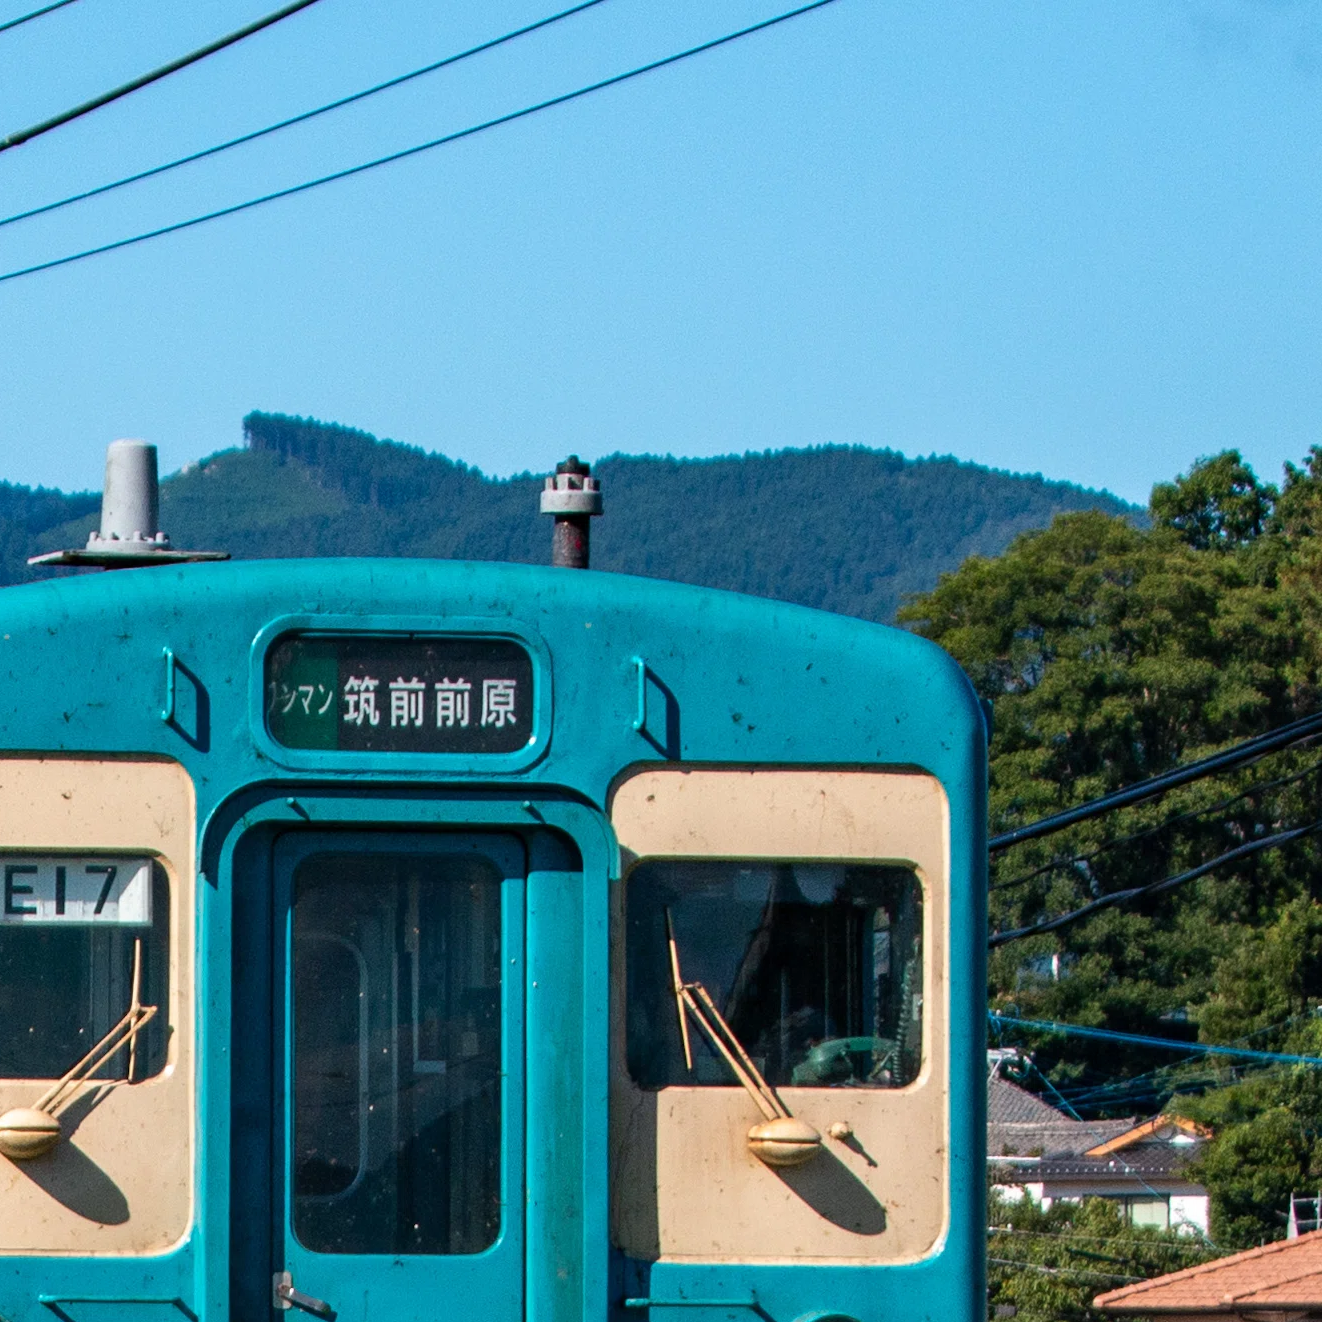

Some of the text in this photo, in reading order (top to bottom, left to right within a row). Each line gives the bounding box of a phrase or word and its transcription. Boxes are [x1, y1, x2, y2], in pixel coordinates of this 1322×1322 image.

[343, 675, 518, 728] 筑前前原
[4, 864, 118, 916] E17
